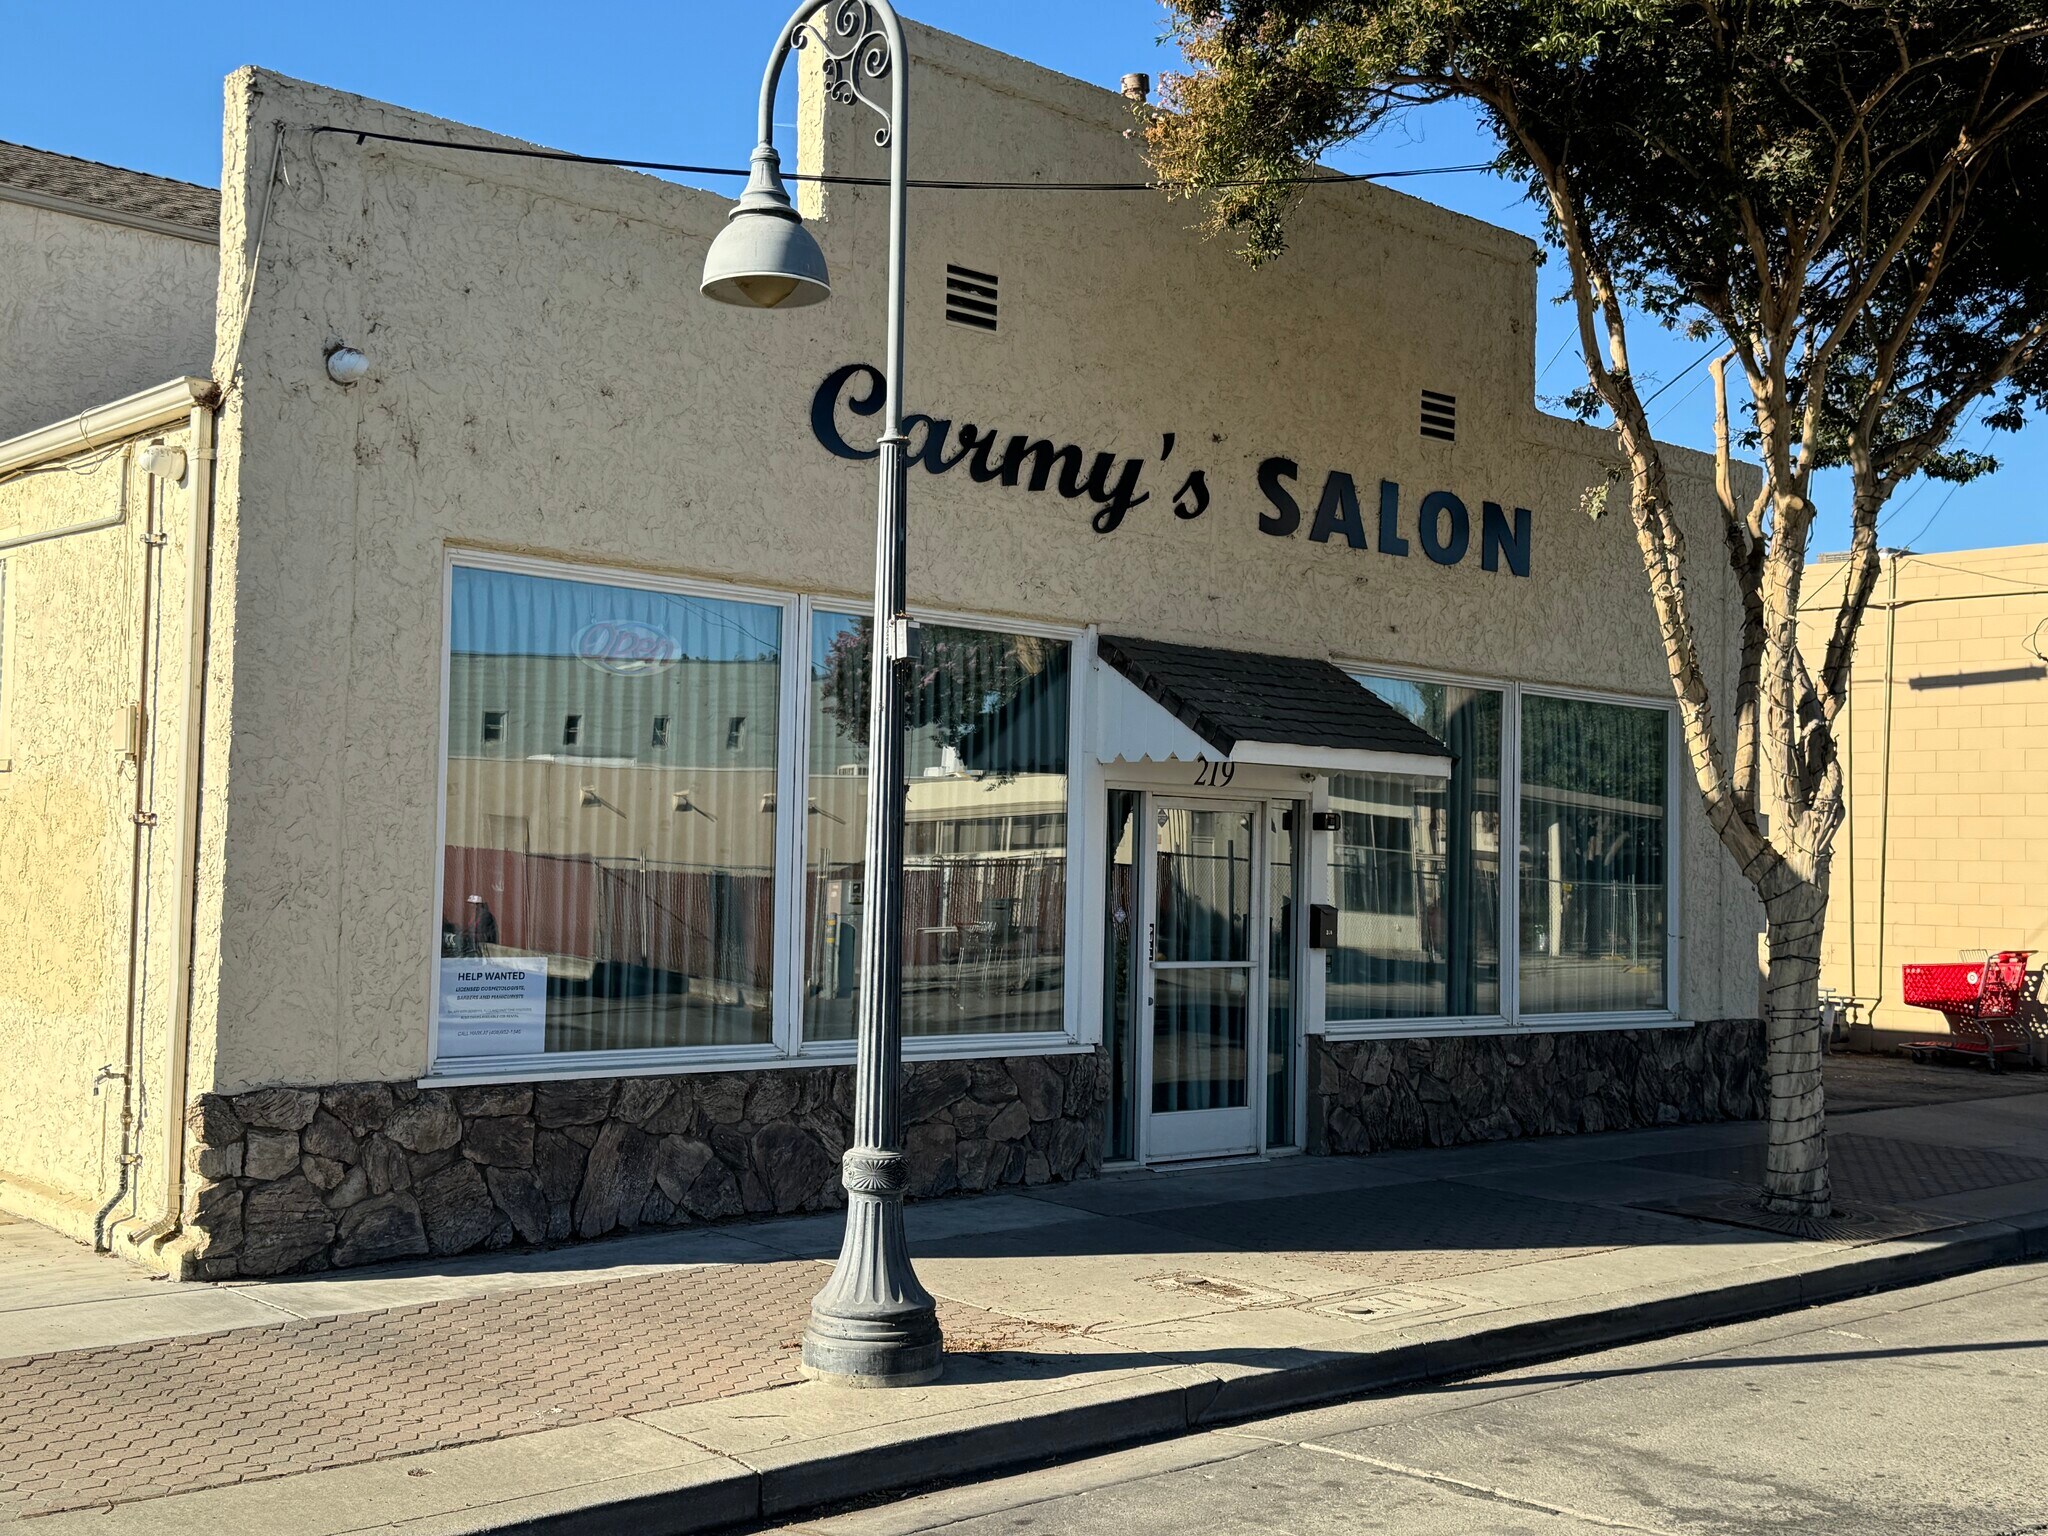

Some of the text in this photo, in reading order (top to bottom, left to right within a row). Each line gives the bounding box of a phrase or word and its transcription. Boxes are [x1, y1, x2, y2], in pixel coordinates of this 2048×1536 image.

[811, 363, 1532, 578] Carmy's SALON
[1194, 756, 1235, 787] 219
[458, 971, 526, 981] HELP WANTED
